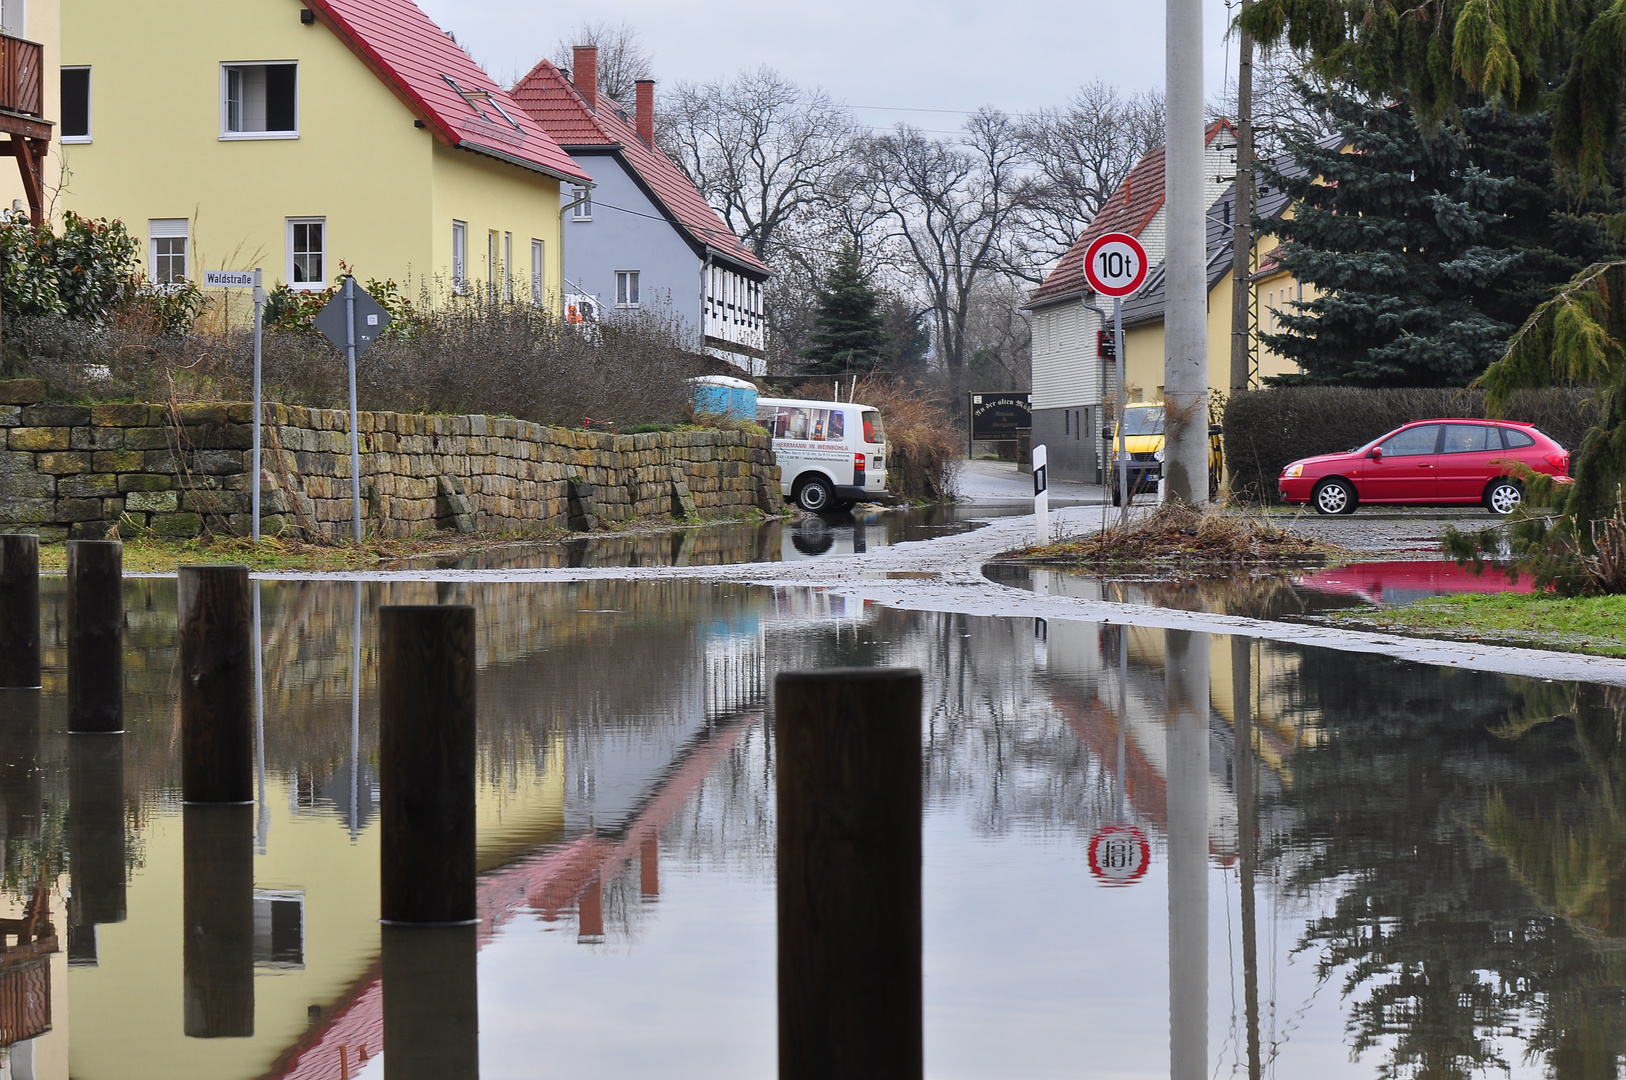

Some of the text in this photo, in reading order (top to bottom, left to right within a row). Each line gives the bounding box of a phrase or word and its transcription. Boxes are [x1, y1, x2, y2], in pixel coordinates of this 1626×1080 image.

[1099, 252, 1132, 278] 10t
[207, 273, 252, 284] Waldstraße
[985, 401, 997, 409] der
